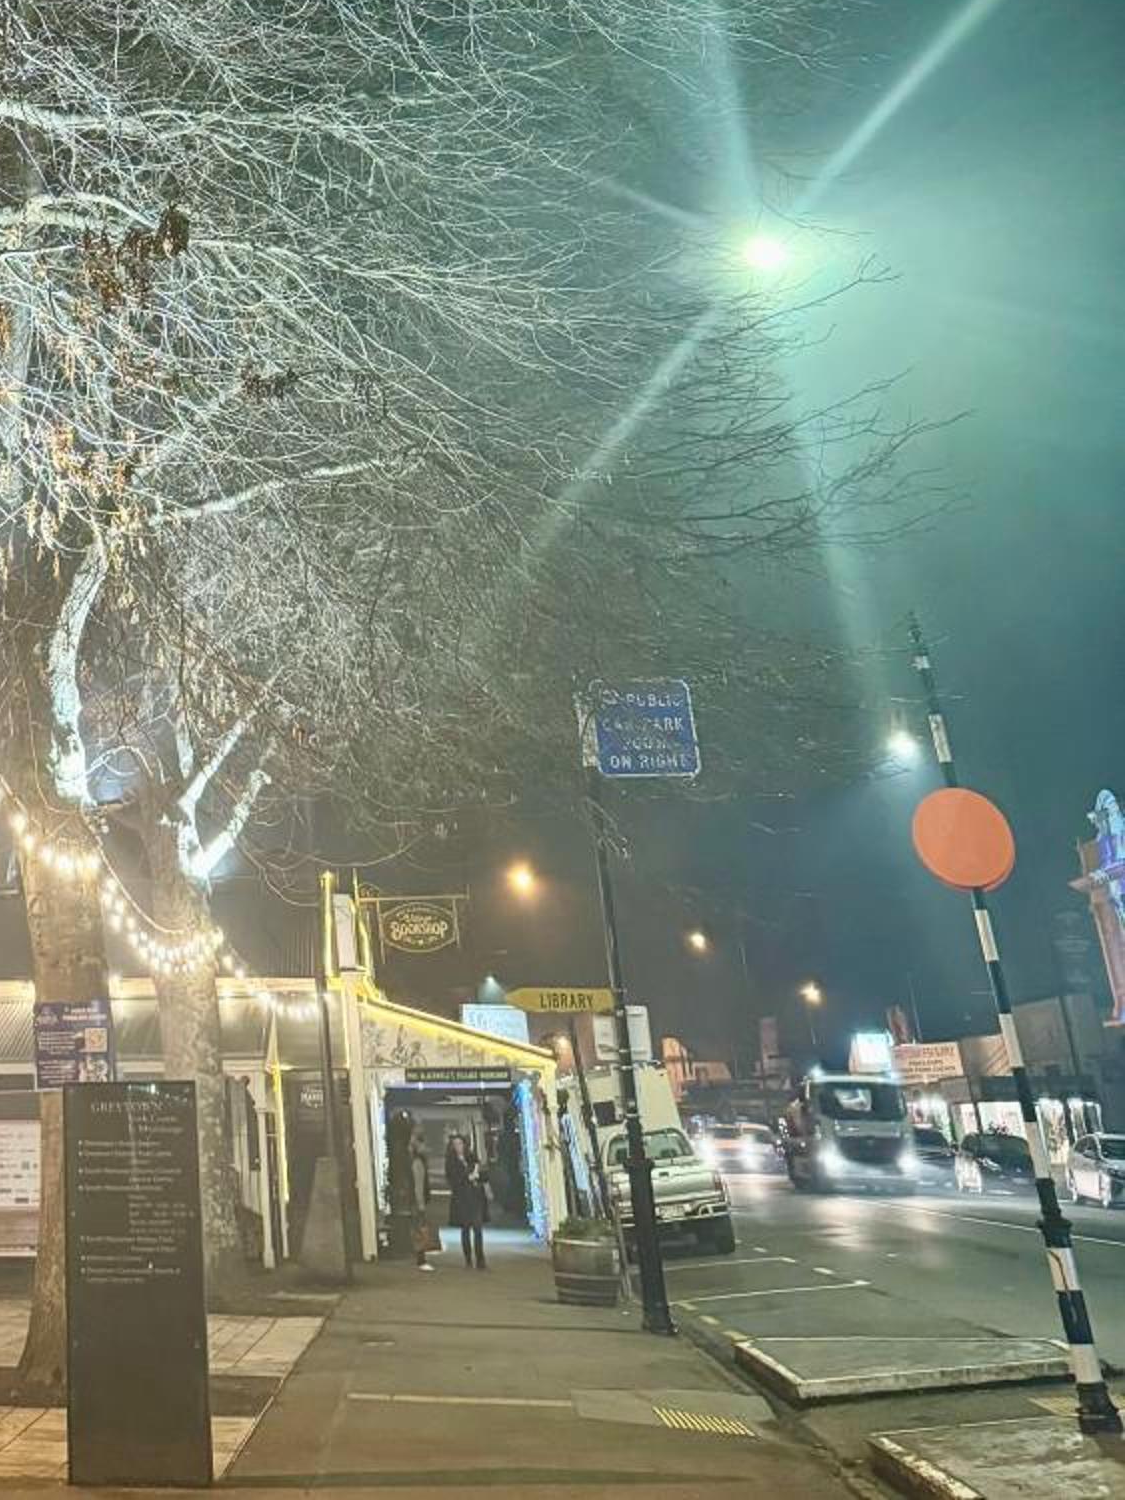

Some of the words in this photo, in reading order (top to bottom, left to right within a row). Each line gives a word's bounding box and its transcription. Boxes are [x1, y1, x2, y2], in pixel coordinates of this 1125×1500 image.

[610, 755, 632, 769] ON
[638, 754, 688, 769] RIGHT
[390, 919, 449, 941] BOOKSHOP
[539, 992, 594, 1009] LIBRARY
